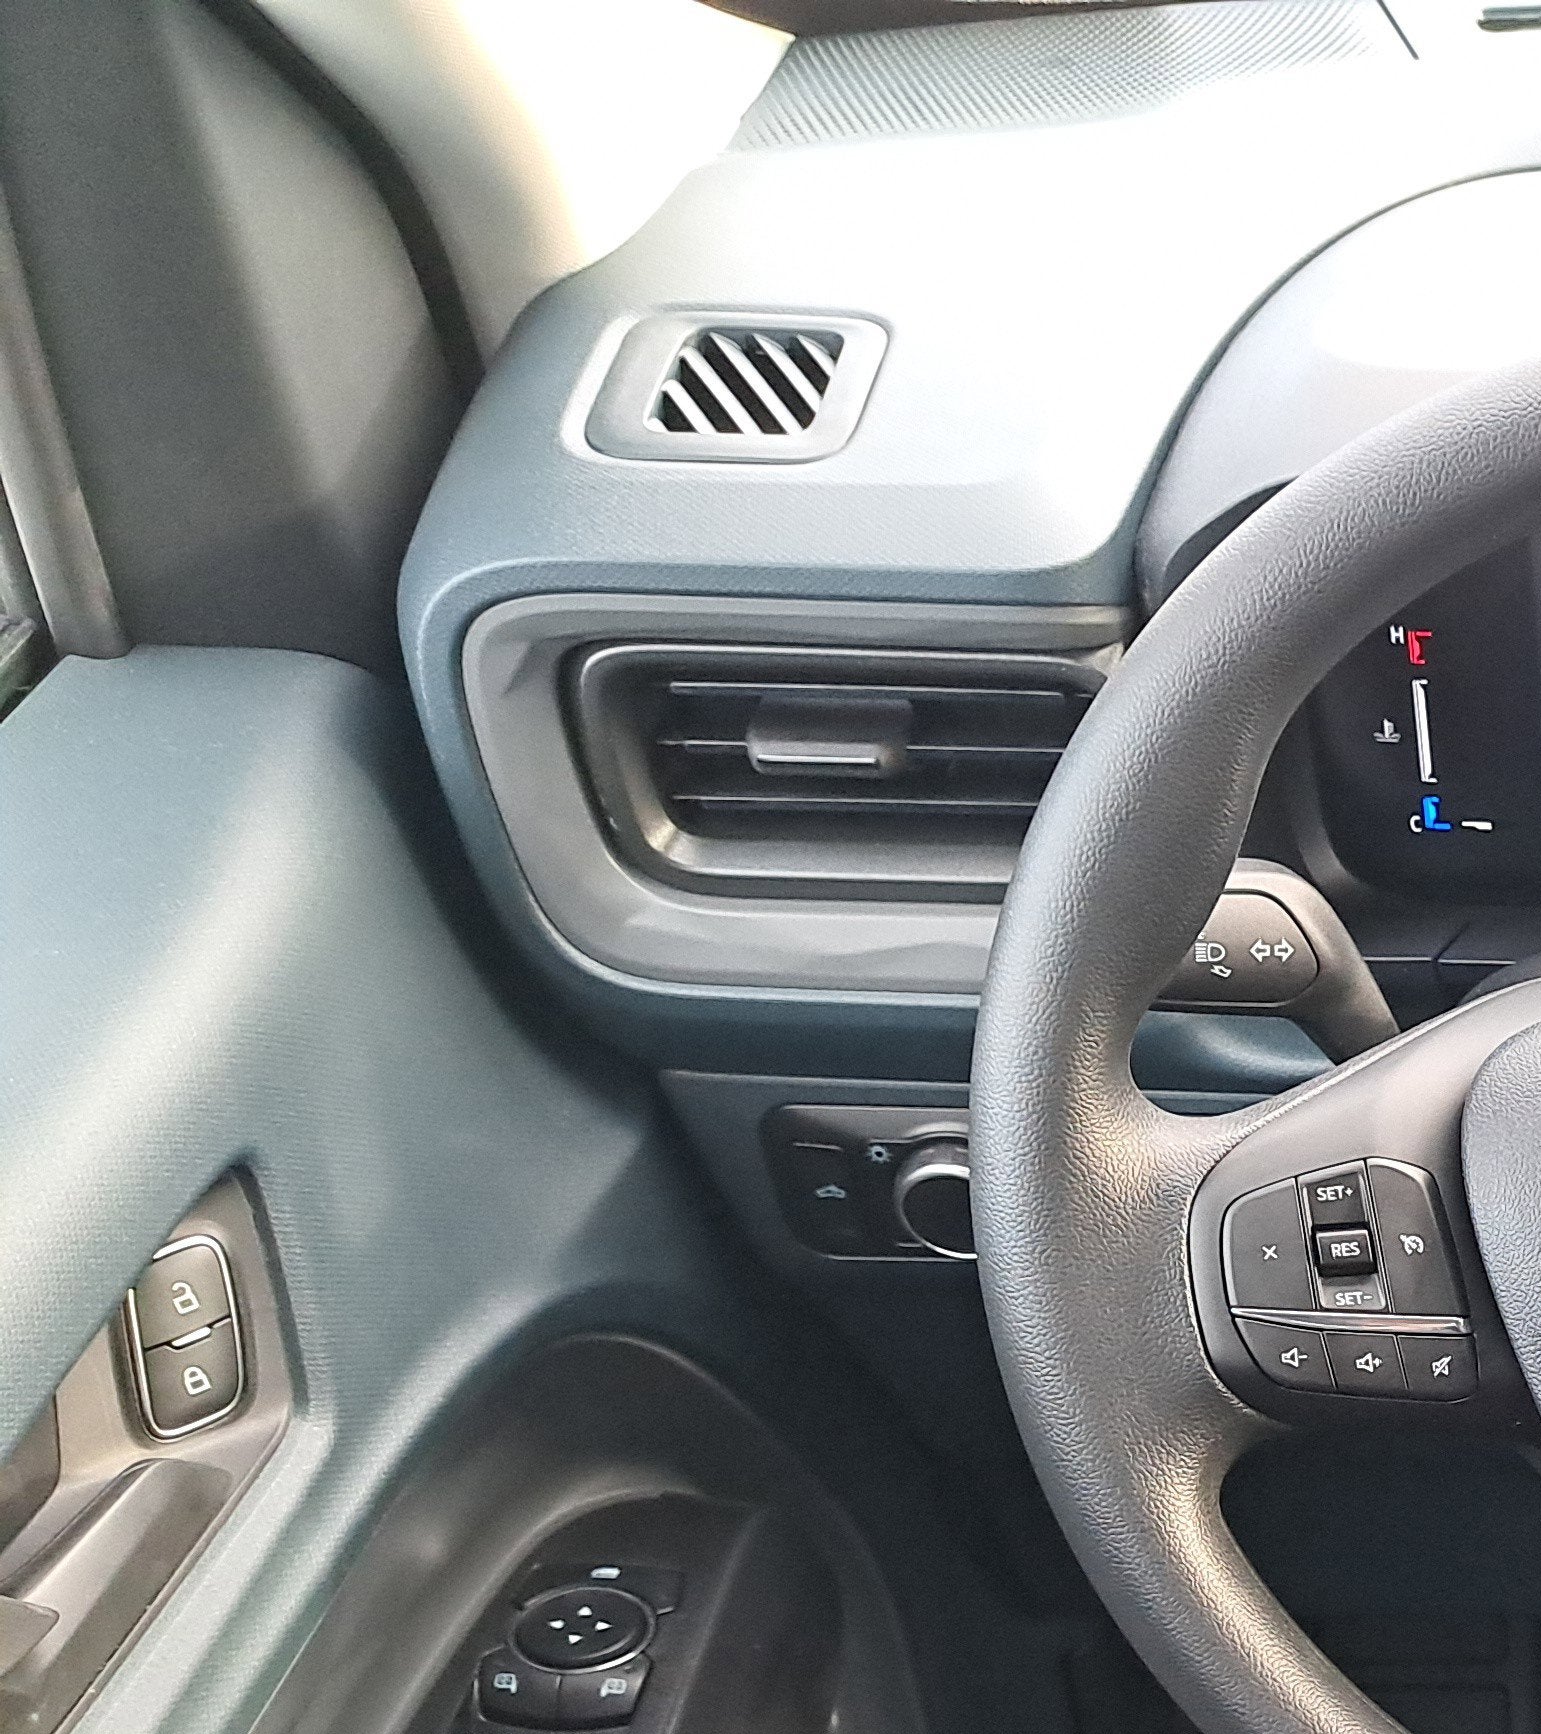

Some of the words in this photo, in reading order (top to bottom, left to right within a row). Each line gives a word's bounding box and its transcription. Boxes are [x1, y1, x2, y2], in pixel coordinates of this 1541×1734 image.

[1389, 626, 1405, 644] H
[1408, 814, 1423, 833] C
[1316, 1184, 1354, 1202] SET+
[1330, 1241, 1361, 1260] RES
